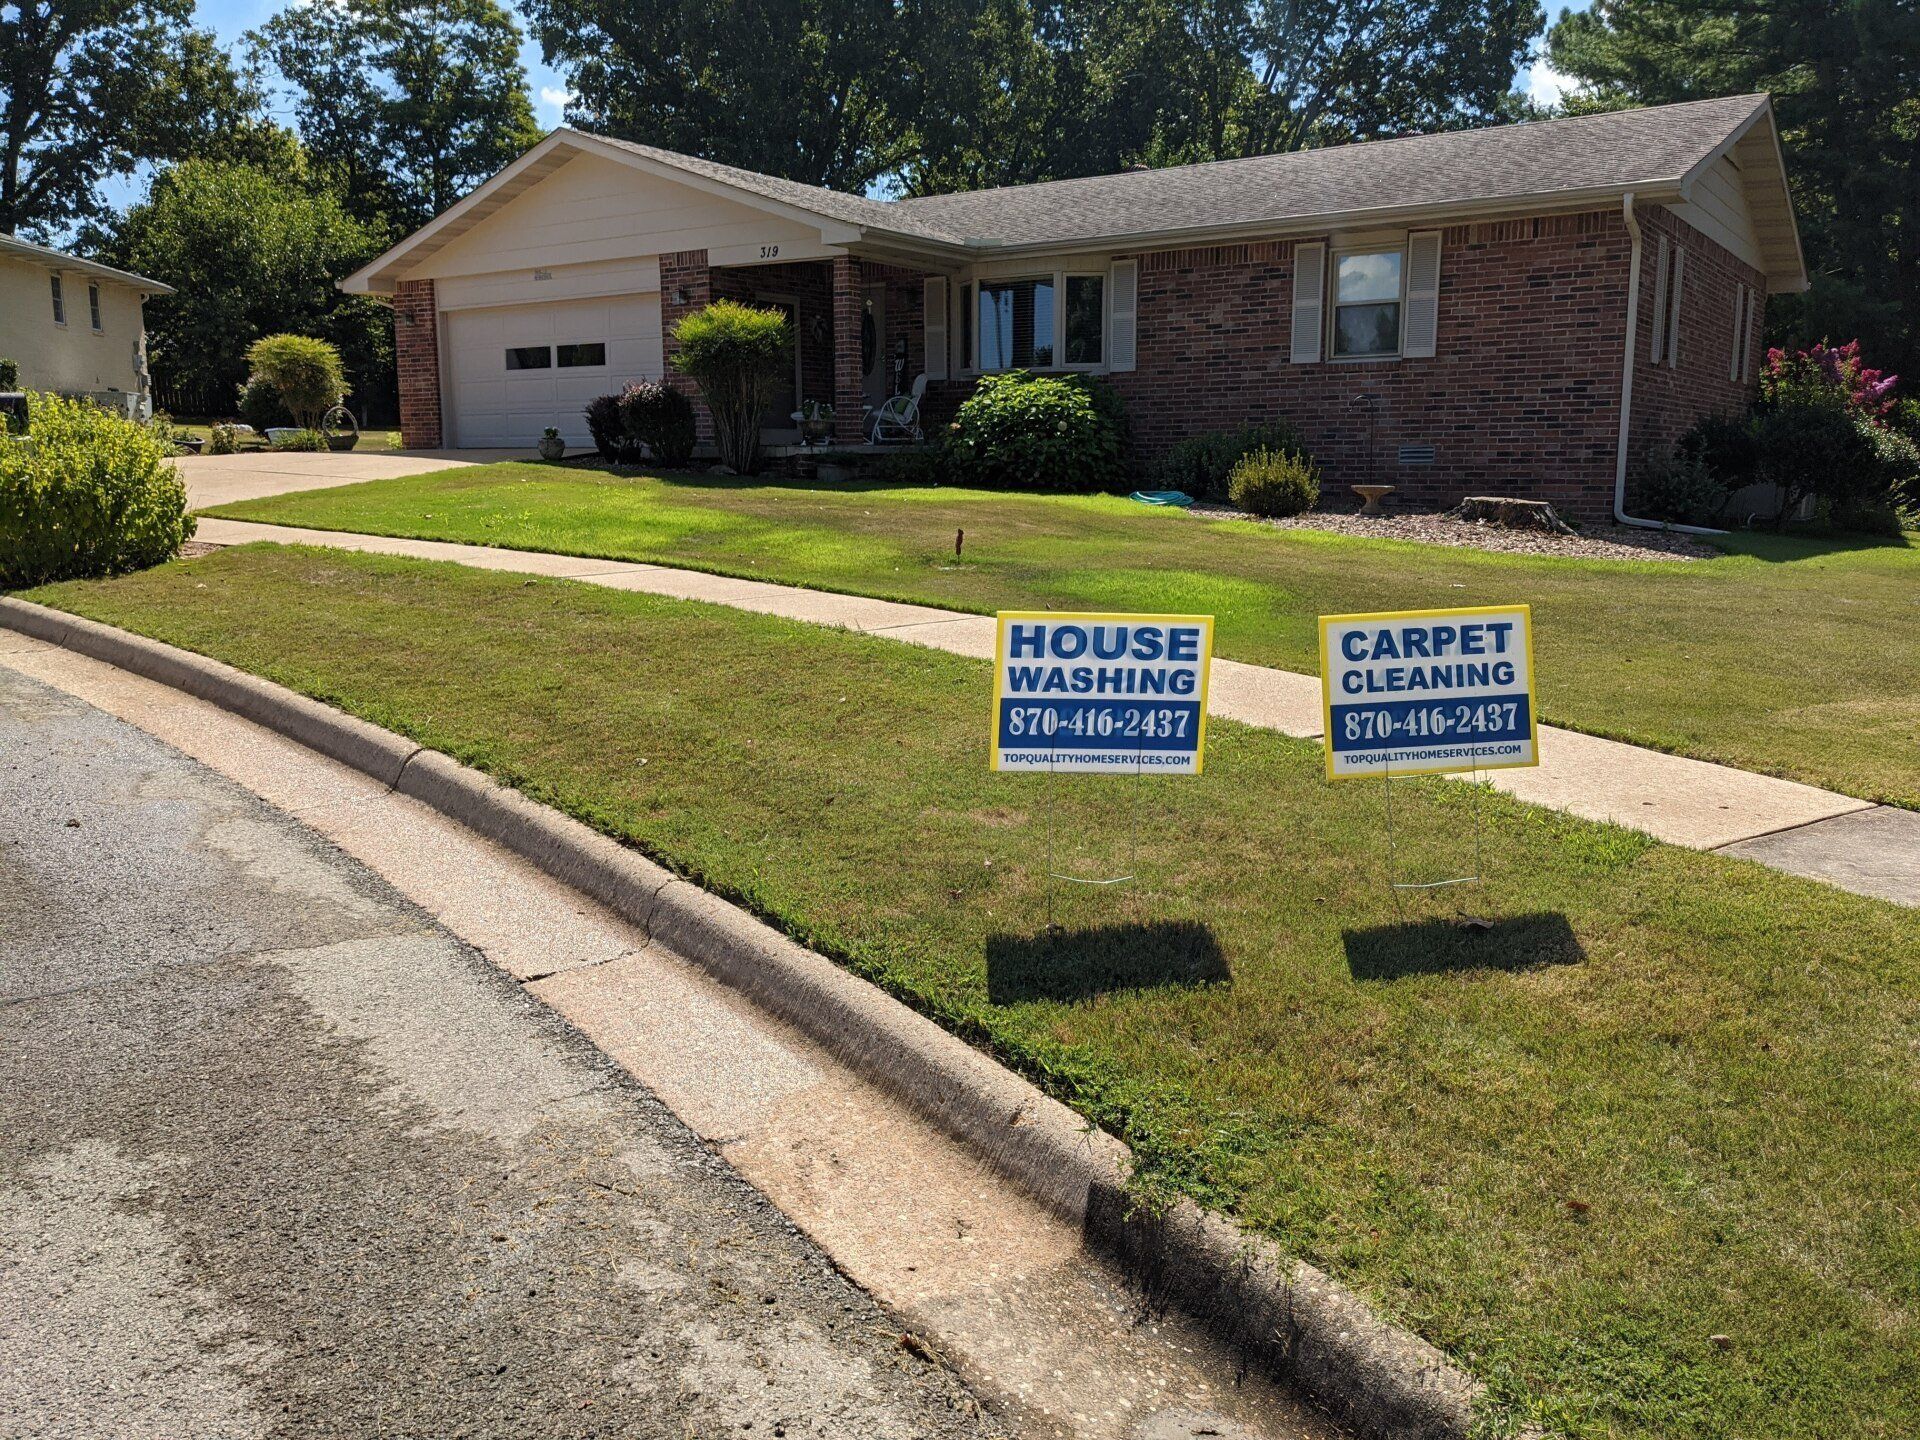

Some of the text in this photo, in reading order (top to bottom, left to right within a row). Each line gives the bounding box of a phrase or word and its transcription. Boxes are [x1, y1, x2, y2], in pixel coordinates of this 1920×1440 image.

[760, 246, 779, 258] 319
[1009, 624, 1200, 662] HOUSE
[1341, 622, 1513, 662] CARPET
[1007, 666, 1195, 695] WASHING
[1342, 661, 1515, 694] CLEANING
[1008, 707, 1190, 738] 870-416-2437
[1344, 702, 1518, 740] 870-416-2437
[1003, 753, 1190, 765] TOPQUALITYHOMESERVICES.COM
[1344, 744, 1521, 765] TOPQUALITYHOMESERVICES.COM
